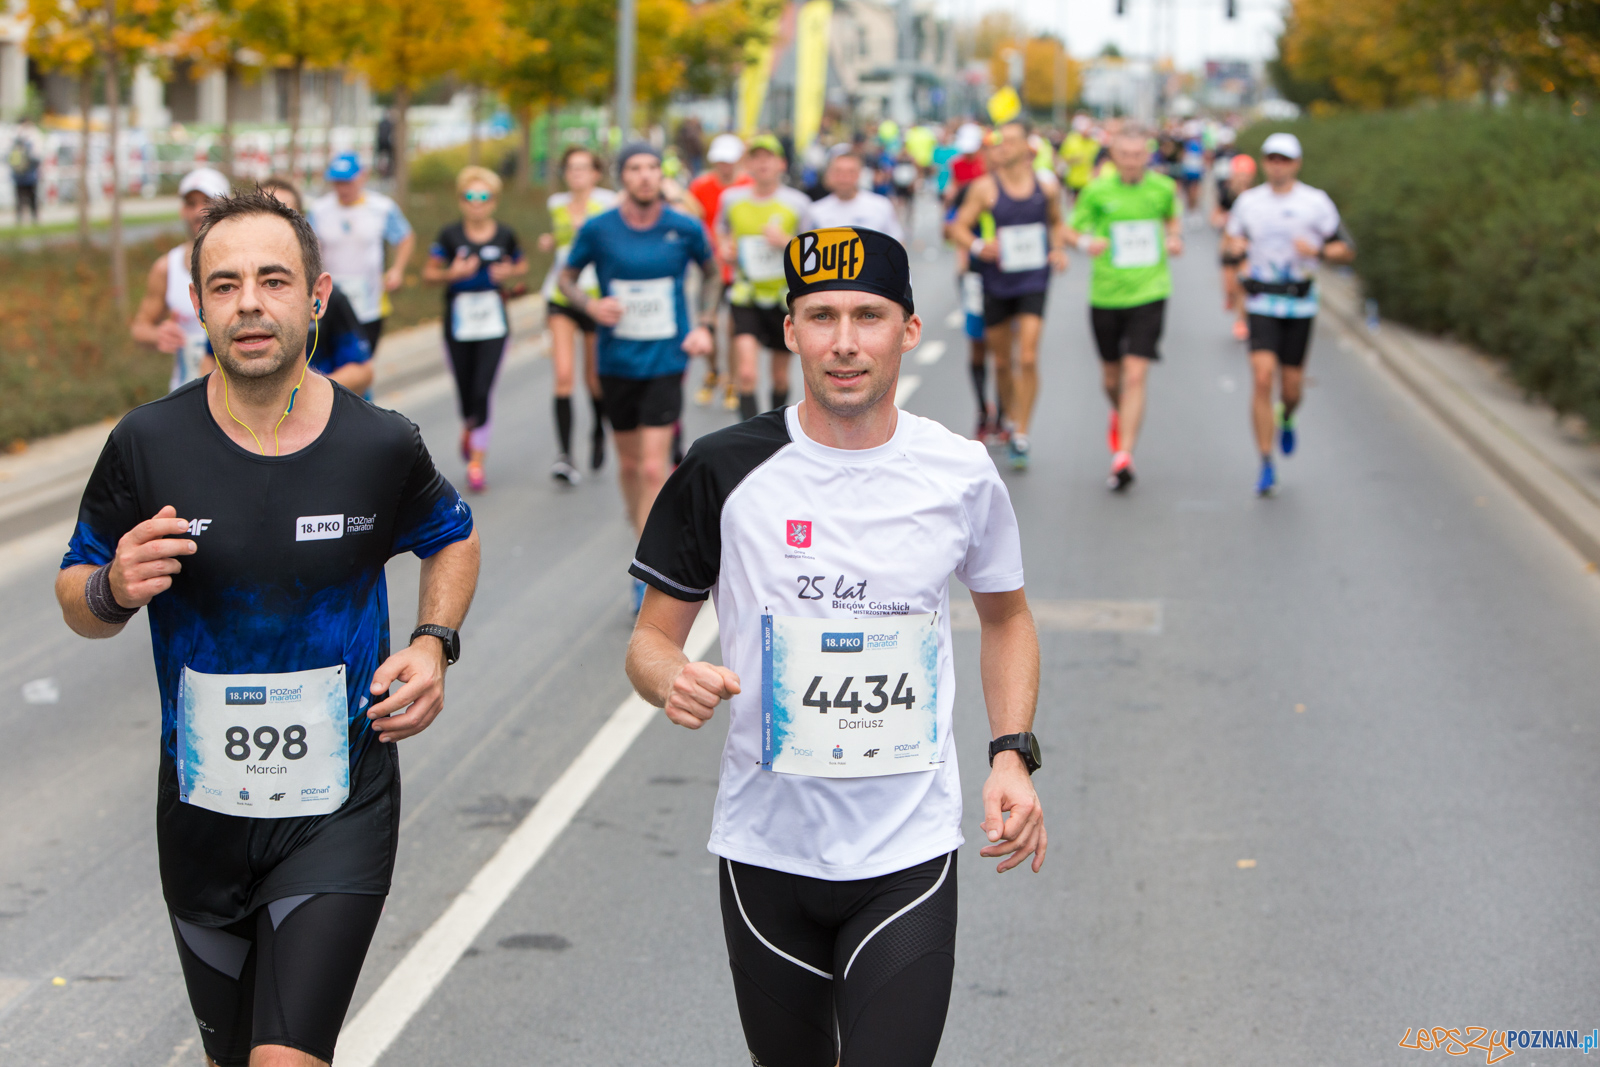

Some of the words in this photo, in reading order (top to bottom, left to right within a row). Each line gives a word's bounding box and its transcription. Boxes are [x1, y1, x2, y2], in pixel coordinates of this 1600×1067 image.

[300, 523, 316, 534] 18.
[317, 521, 340, 533] PKO
[346, 523, 374, 533] maraton
[797, 575, 825, 600] 25
[832, 574, 867, 601] lat
[825, 638, 839, 647] 18.
[840, 638, 861, 647] PKO
[866, 639, 898, 648] maraton
[229, 692, 242, 700] 18.
[243, 691, 263, 700] PKO
[269, 693, 302, 701] maraton
[802, 672, 916, 714] 4434
[838, 718, 884, 730] Dariusz
[224, 724, 308, 761] 898
[246, 764, 288, 775] Marcin
